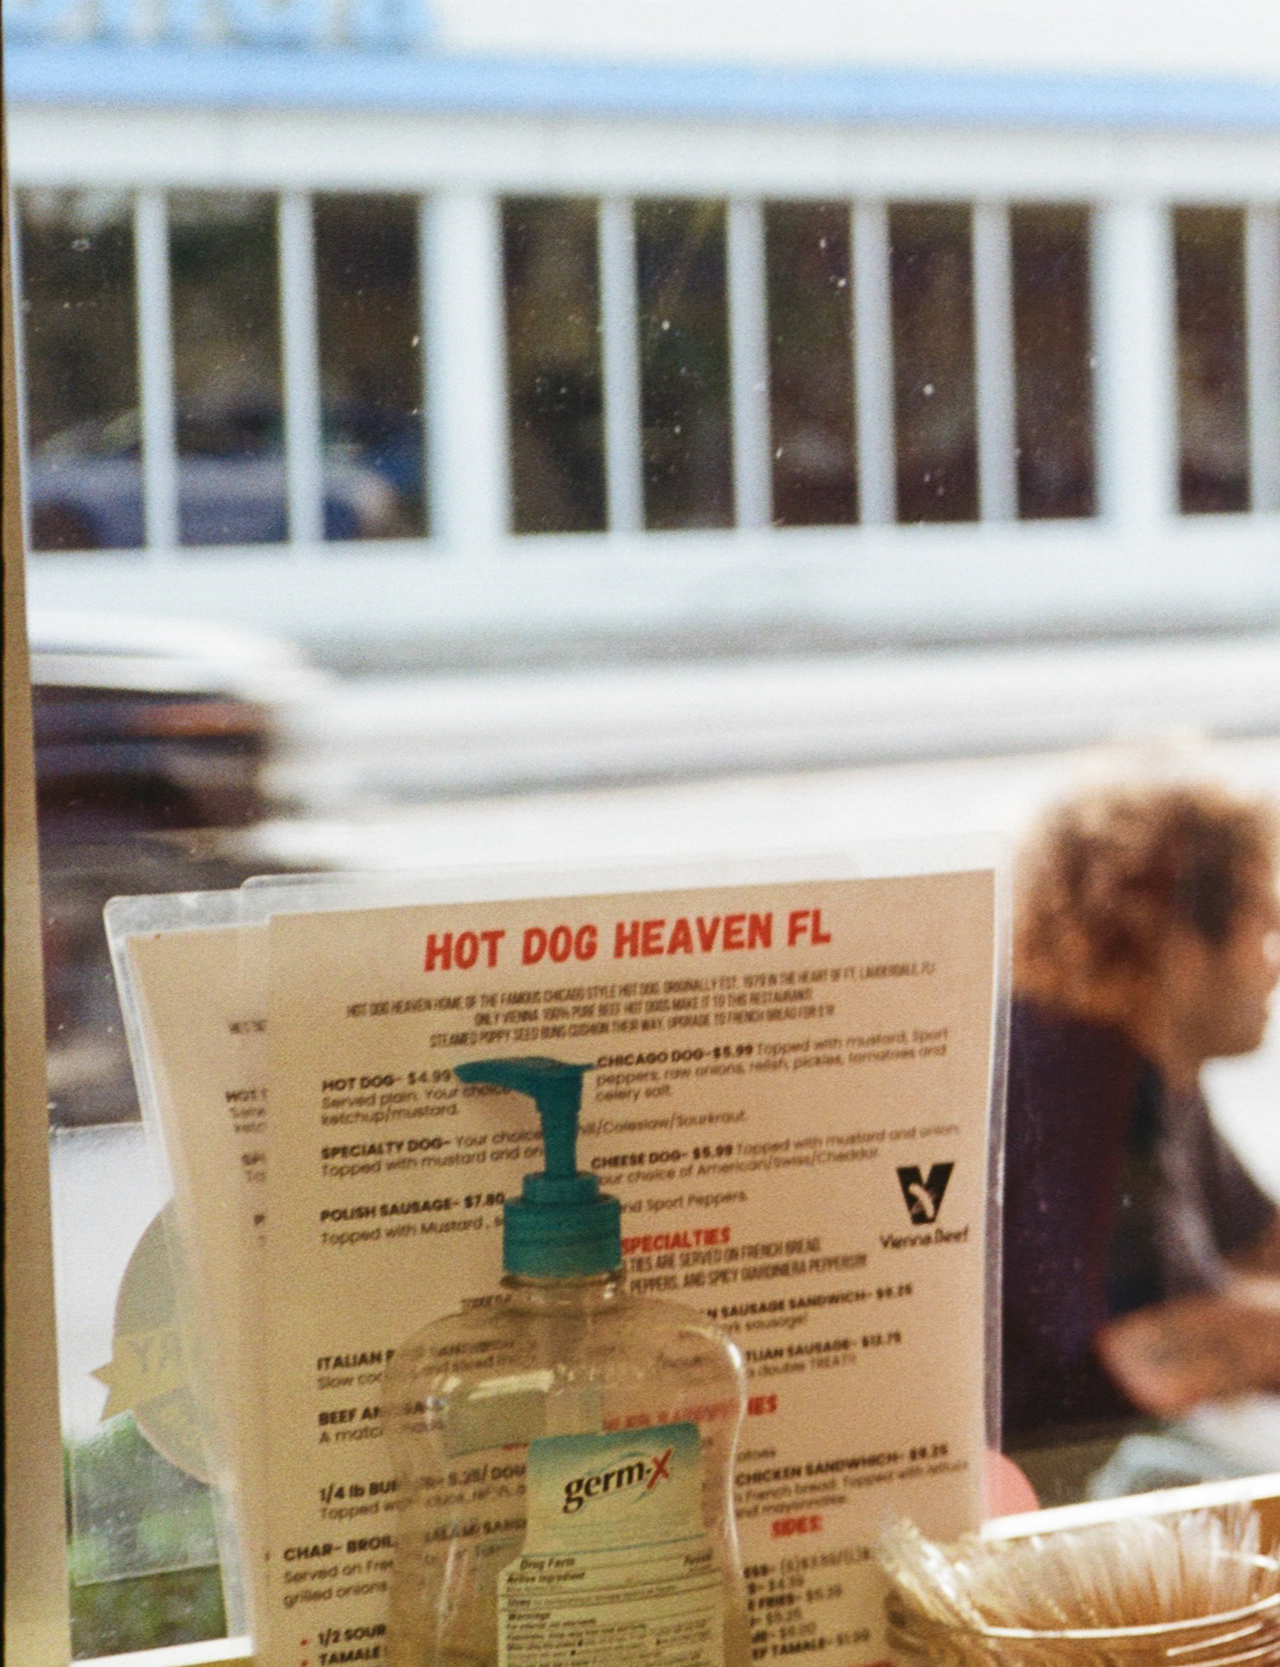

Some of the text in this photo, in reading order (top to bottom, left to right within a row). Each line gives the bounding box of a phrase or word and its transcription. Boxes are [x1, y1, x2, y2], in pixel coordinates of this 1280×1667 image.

[424, 907, 832, 972] HOT DOG HEAVEN FL
[390, 998, 432, 1015] HEAVEN
[434, 996, 463, 1013] HOME
[481, 994, 498, 1008] THE
[501, 991, 541, 1007] FAMOUS
[543, 988, 585, 1004] CHICAGO
[587, 985, 617, 1000] STYLE
[664, 976, 717, 993] ORIGINALLY
[799, 969, 828, 984] HEART
[475, 1012, 498, 1027] ONLY
[502, 1009, 538, 1025] VIENNA
[572, 1006, 595, 1020] PURE
[672, 996, 699, 1011] MAKE
[430, 1032, 478, 1048] STEAMED
[480, 1030, 511, 1046] POPPY
[513, 1027, 538, 1041] SEED
[667, 1012, 710, 1030] UPGRADE
[727, 1009, 765, 1025] FRENCH
[597, 1050, 669, 1070] CHICAGO
[757, 1040, 812, 1058] Topped
[815, 1037, 842, 1051] with
[664, 1065, 691, 1080] raw
[848, 1046, 915, 1064] tomatoes
[919, 1041, 946, 1059] and
[322, 1077, 355, 1092] HOT
[407, 1068, 450, 1086] $4.99
[322, 1087, 458, 1110] Served Your
[595, 1085, 640, 1104] celery
[322, 1138, 403, 1160] SPECIALTY
[455, 1133, 488, 1148] Your
[591, 1152, 646, 1170] CHEESE
[737, 1139, 790, 1159] Topped
[794, 1134, 823, 1150] with
[826, 1129, 886, 1147] mustard
[890, 1125, 917, 1141] and
[322, 1145, 520, 1179] Topped with mustard and
[627, 1166, 676, 1183] choice
[679, 1164, 694, 1179] of
[320, 1206, 376, 1223] POLISH
[321, 1228, 382, 1246] Topped
[385, 1223, 417, 1239] with
[420, 1217, 484, 1234] Mustard
[647, 1195, 684, 1213] Sport
[656, 1254, 676, 1271] ARE
[680, 1248, 721, 1268] SERVED
[741, 1243, 781, 1261] FRENCH
[683, 1271, 705, 1289] AND
[708, 1268, 738, 1286] SPICY
[721, 1301, 785, 1319] SAUSAGE
[317, 1350, 381, 1371] ITALIAN
[319, 1408, 357, 1426] BEEF
[562, 1447, 674, 1514] germ-X
[735, 1465, 801, 1485] CHICKEN
[843, 1471, 893, 1488] Topped
[897, 1464, 924, 1479] with
[319, 1482, 365, 1504] 1/4 lb
[320, 1502, 379, 1520] Topped
[284, 1564, 361, 1584] Served on
[283, 1586, 333, 1609] grilled
[318, 1627, 341, 1648] 1/2
[318, 1645, 381, 1667] TAMALE
